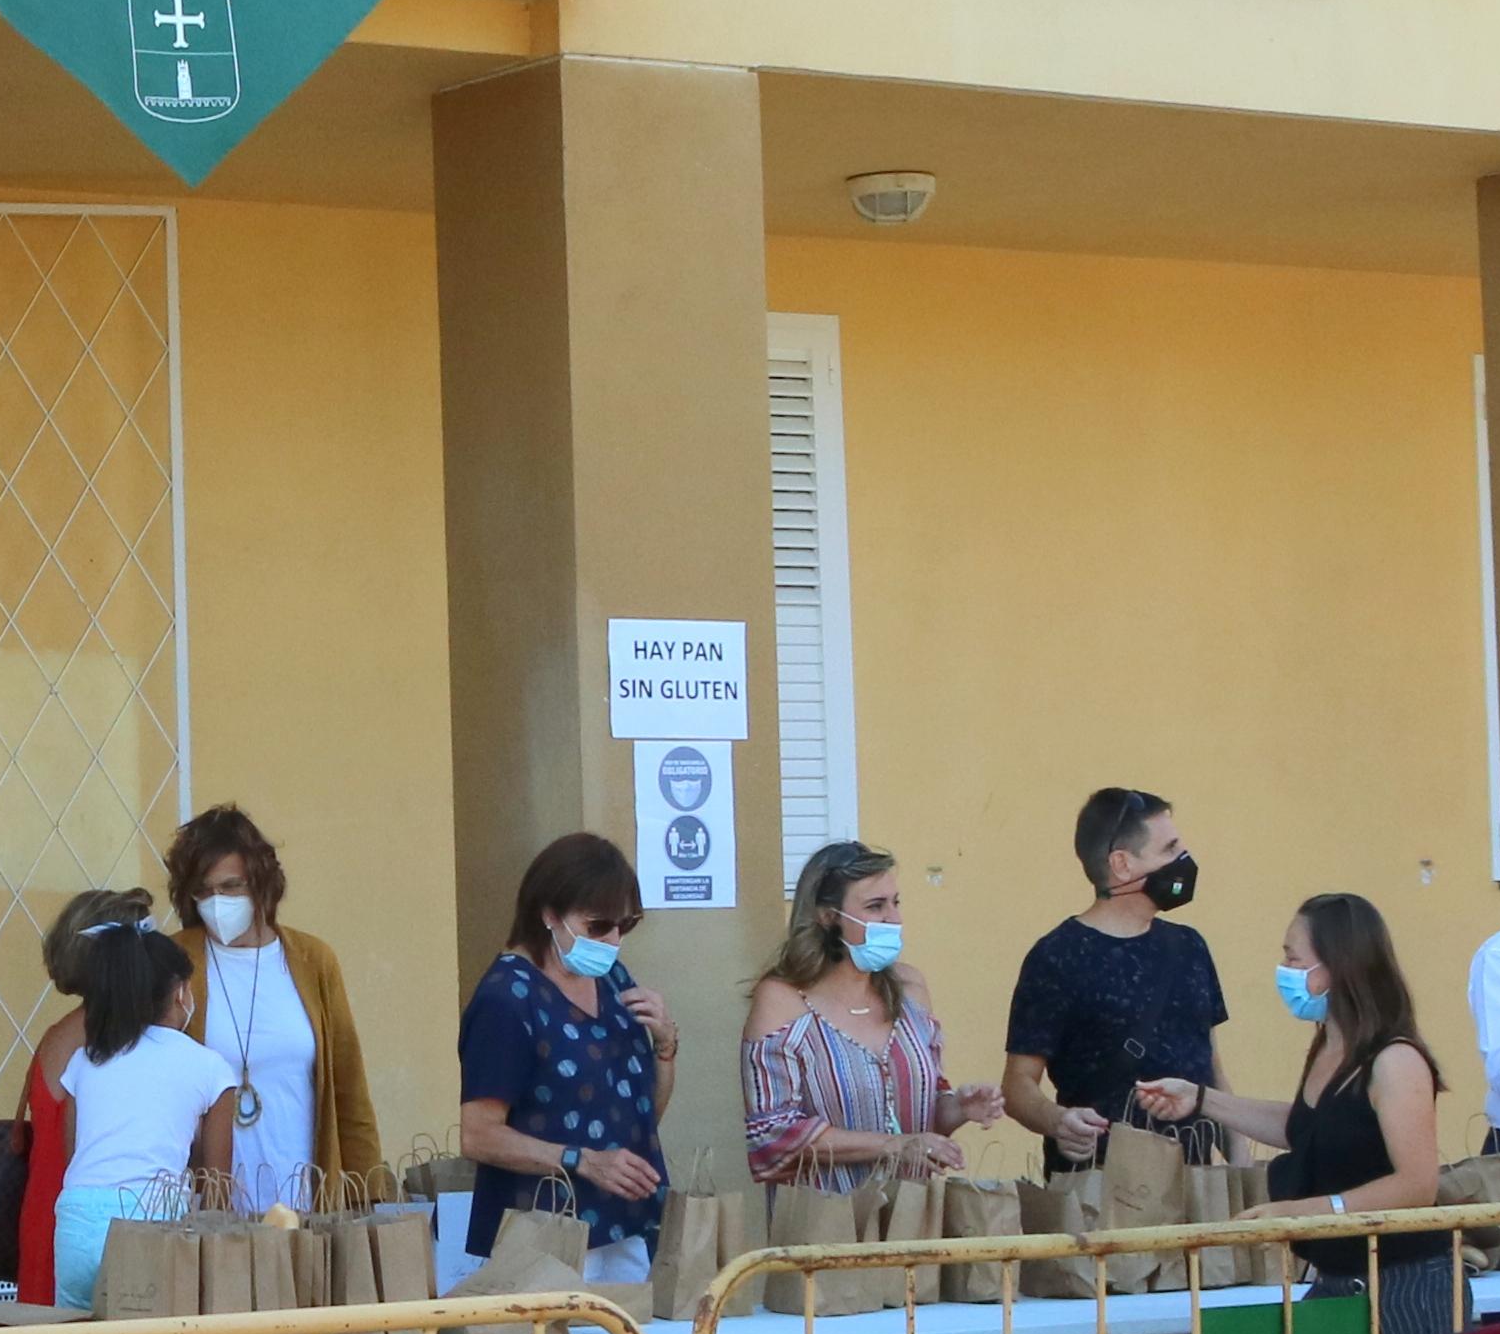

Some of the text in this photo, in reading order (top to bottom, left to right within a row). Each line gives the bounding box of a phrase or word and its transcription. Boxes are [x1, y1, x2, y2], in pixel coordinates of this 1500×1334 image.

[634, 640, 723, 662] HAY PAN
[619, 679, 738, 700] SIN GLUTEN
